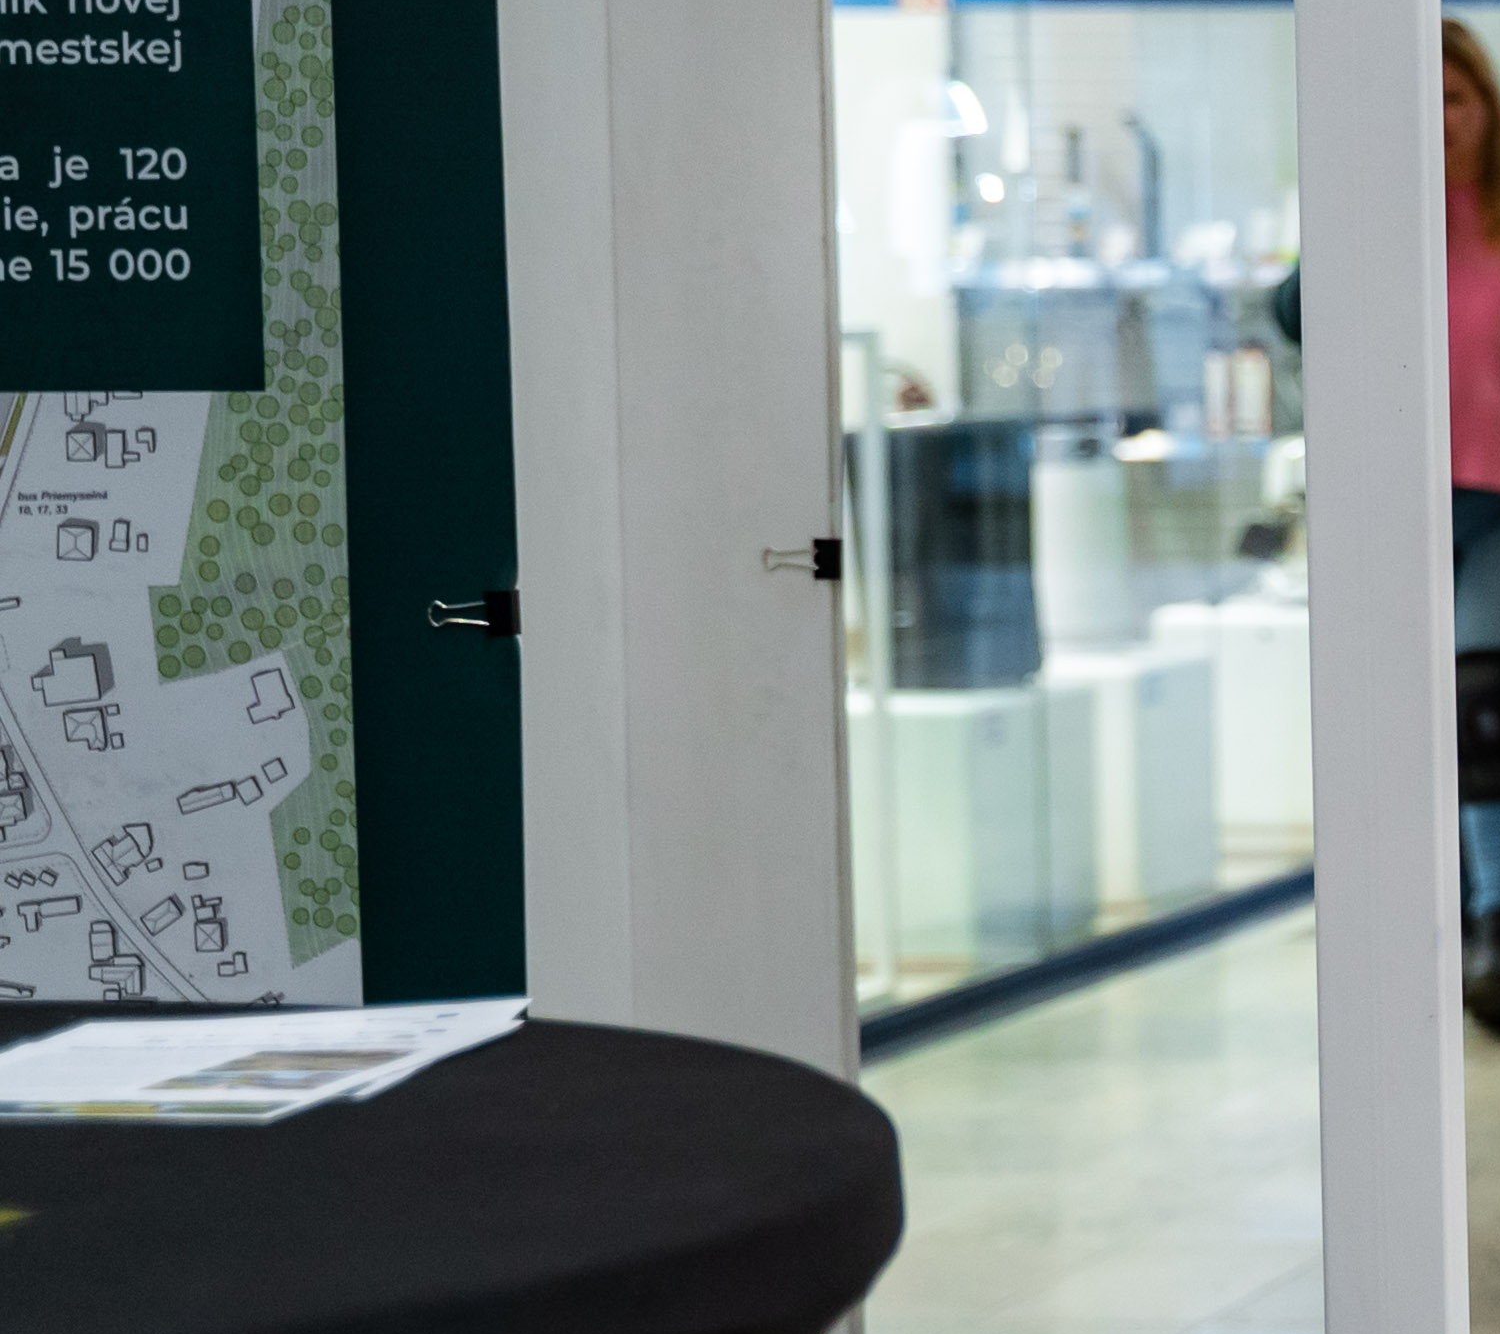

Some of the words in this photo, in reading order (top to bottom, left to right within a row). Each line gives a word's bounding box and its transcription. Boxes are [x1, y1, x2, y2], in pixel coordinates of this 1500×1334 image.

[0, 29, 182, 72] mestskej
[48, 145, 90, 188] je
[119, 147, 188, 180] 120
[69, 197, 188, 239] prácu
[0, 255, 33, 281] e
[50, 248, 91, 281] 15
[109, 248, 191, 281] 000
